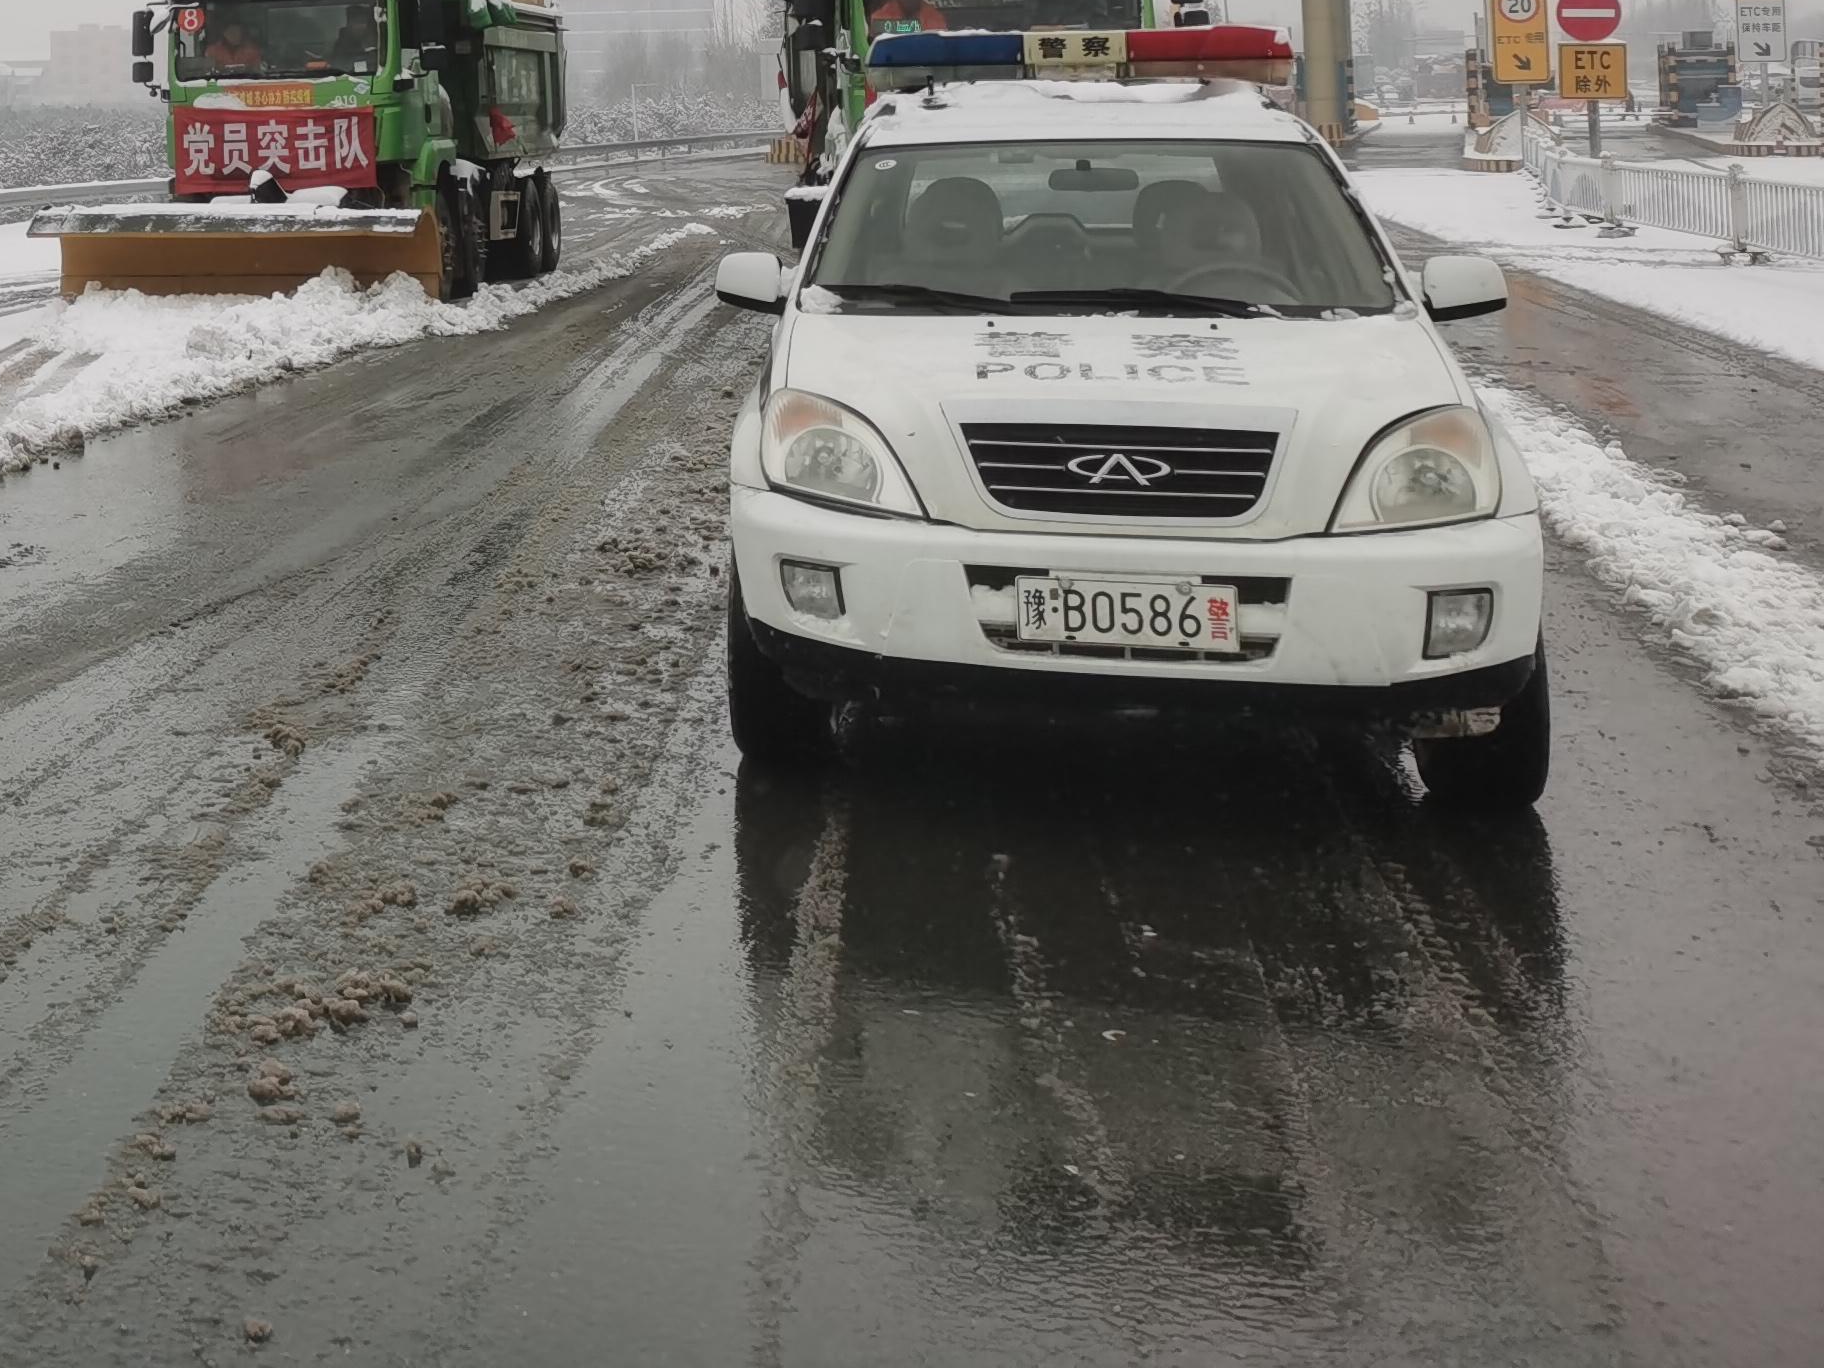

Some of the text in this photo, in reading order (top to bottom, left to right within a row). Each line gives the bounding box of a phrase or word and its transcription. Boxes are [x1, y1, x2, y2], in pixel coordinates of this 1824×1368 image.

[184, 8, 197, 30] 8
[1038, 36, 1110, 59] 警察
[1574, 50, 1612, 70] ETC
[1575, 75, 1612, 94] 除外
[183, 116, 369, 177] 党员突击队
[976, 362, 1251, 385] POLICE
